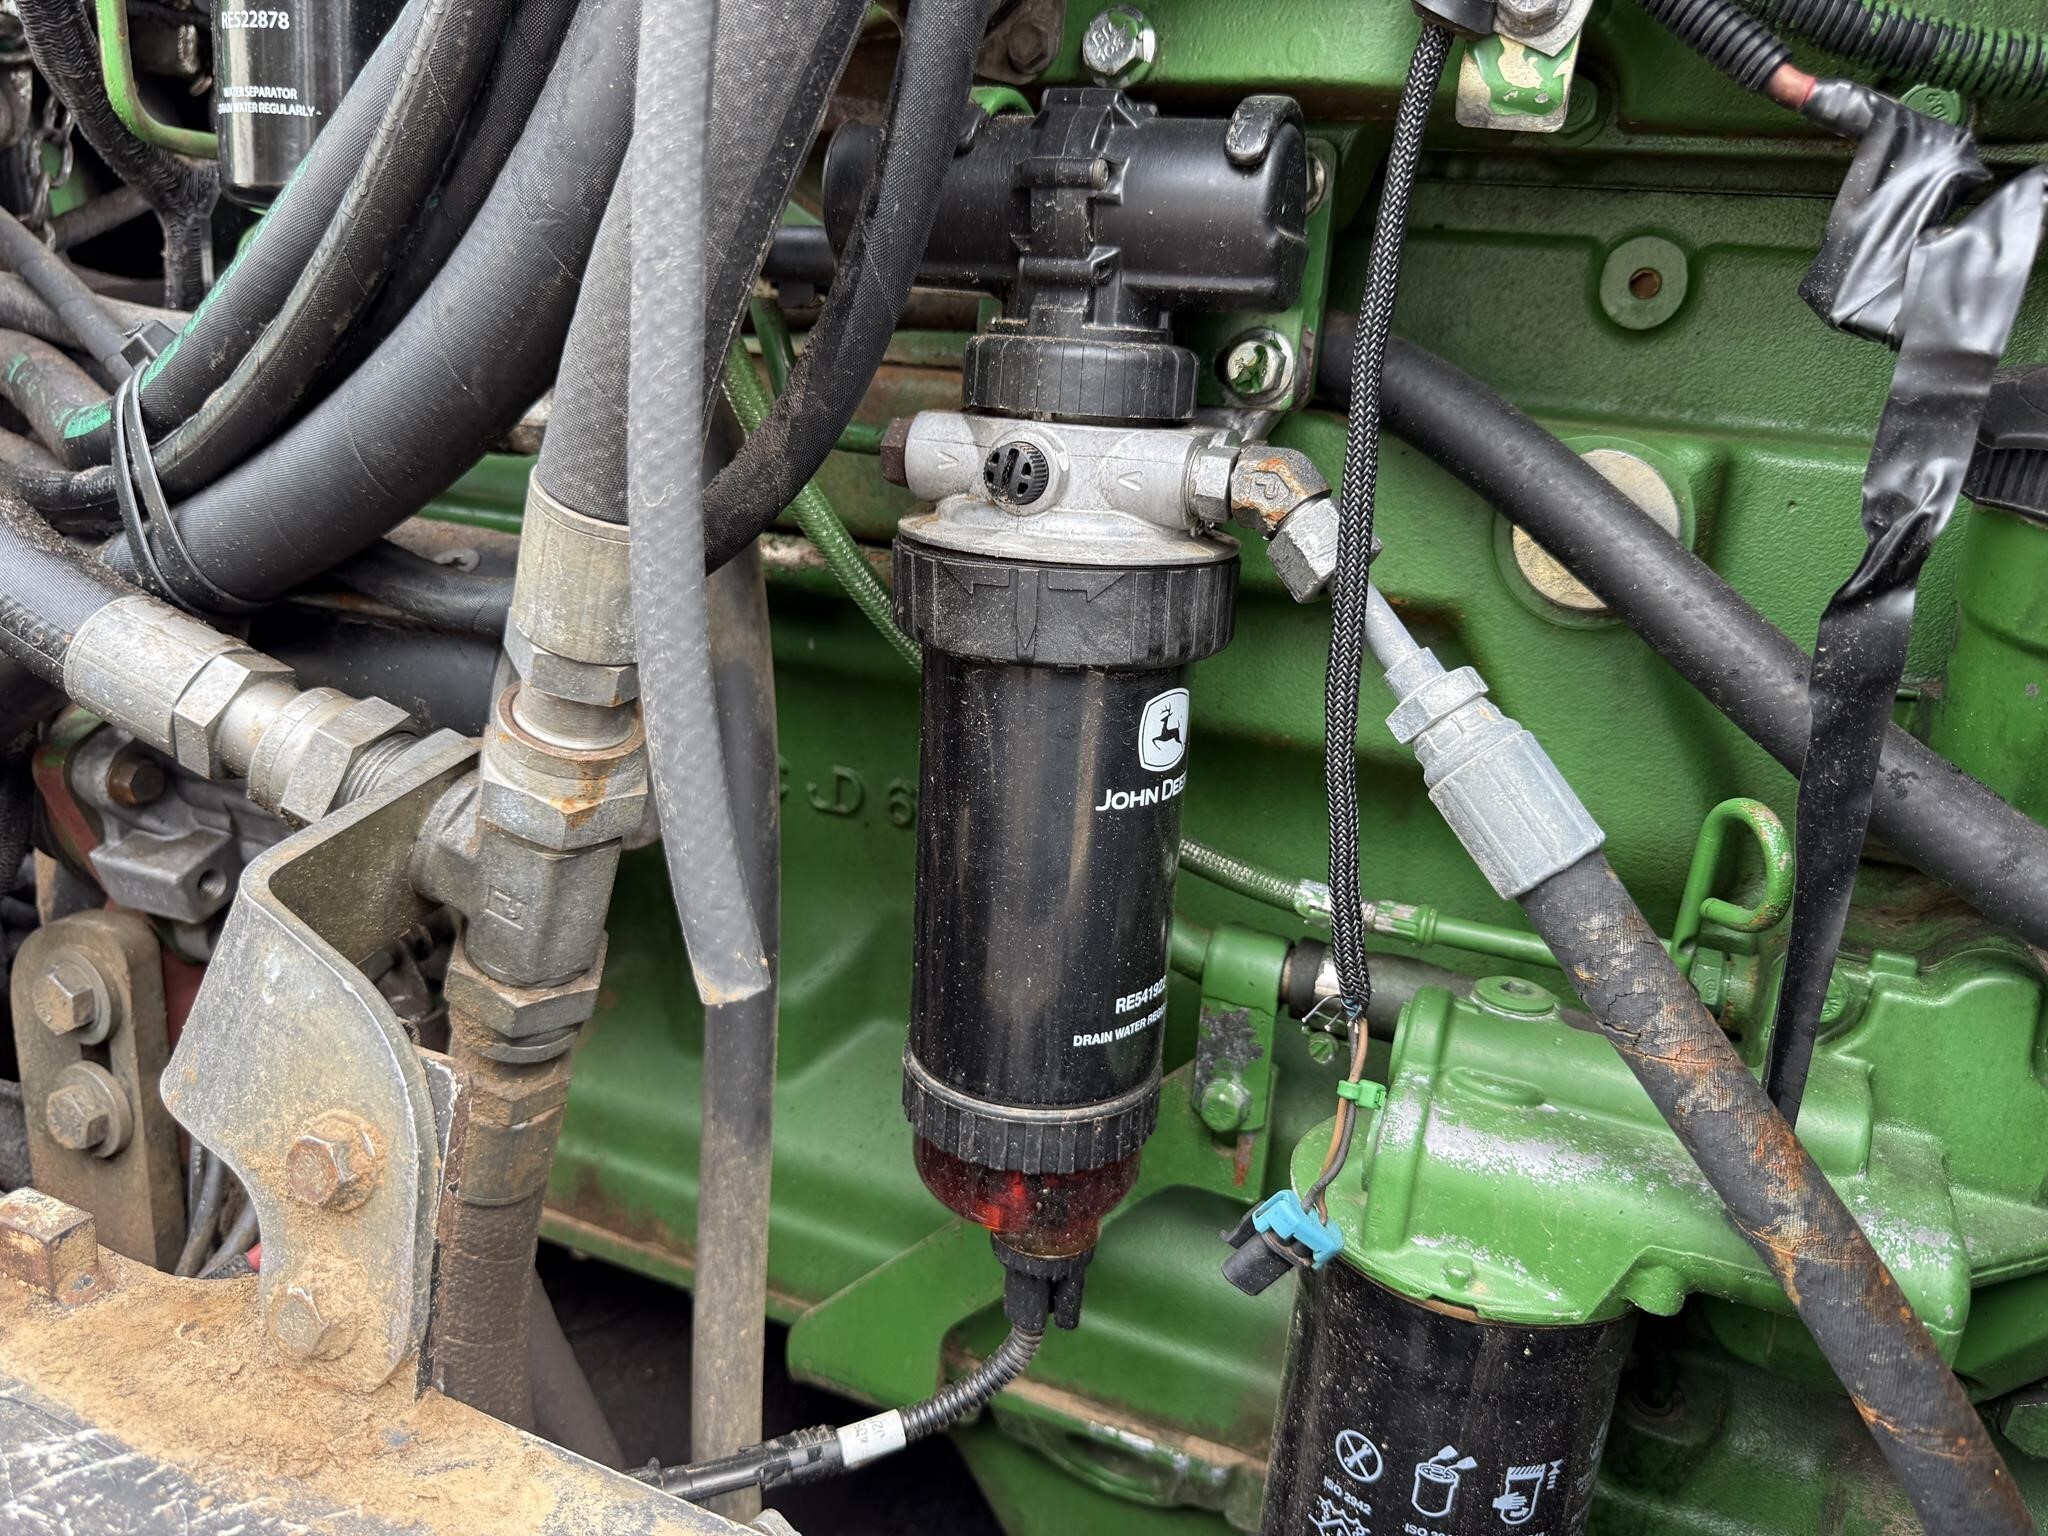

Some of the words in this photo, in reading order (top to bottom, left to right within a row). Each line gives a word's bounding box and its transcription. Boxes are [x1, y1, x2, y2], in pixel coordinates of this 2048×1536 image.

[221, 10, 290, 29] RE522878
[244, 86, 298, 100] SEPARATOR
[232, 102, 258, 113] WATER
[258, 102, 315, 117] REGULARLY
[1095, 786, 1160, 812] JOHN
[1161, 769, 1187, 801] DEE
[1073, 1030, 1114, 1047] DRAIN
[1114, 1017, 1147, 1040] WATER
[1323, 1475, 1344, 1497] ISO
[1343, 1490, 1373, 1517] 2942
[1403, 1522, 1428, 1536] ISO
